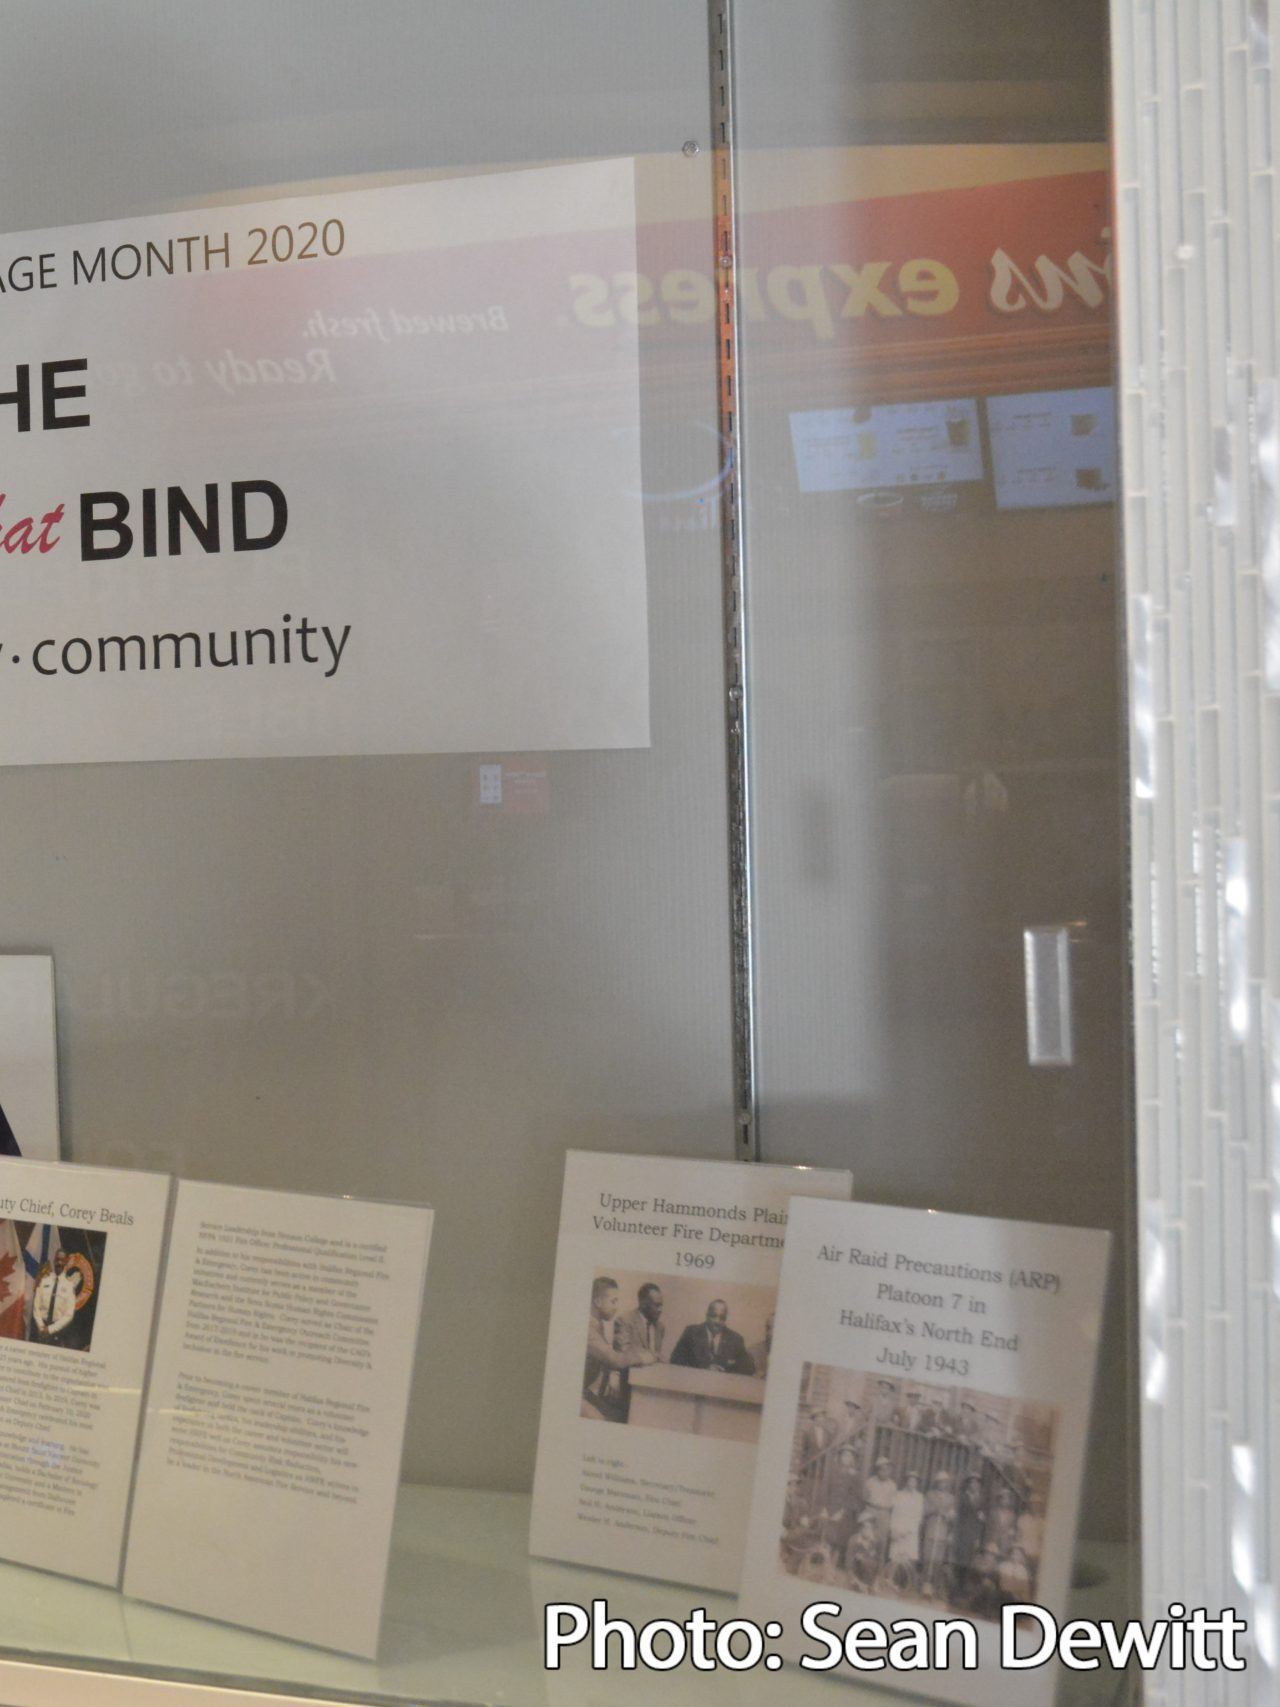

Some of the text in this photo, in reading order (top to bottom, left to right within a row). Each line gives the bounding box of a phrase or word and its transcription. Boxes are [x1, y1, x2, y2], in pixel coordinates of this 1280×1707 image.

[72, 232, 230, 286] MONTH
[246, 218, 345, 266] 2020
[80, 479, 288, 562] BIND
[32, 613, 352, 678] community
[19, 1198, 56, 1218] Chief,
[60, 1203, 97, 1223] Corey
[100, 1208, 134, 1226] Beals
[599, 1193, 648, 1213] Upper
[652, 1198, 746, 1221] Hammonds
[593, 1216, 668, 1237] Volunteer
[673, 1224, 703, 1240] Fire
[675, 1252, 715, 1269] 1969
[817, 1245, 1061, 1294] Air Raid Precautions (ARP)
[876, 1283, 986, 1314] Platoon 7 in
[839, 1309, 1019, 1351] Halifax's North End
[876, 1347, 969, 1376] July 1943
